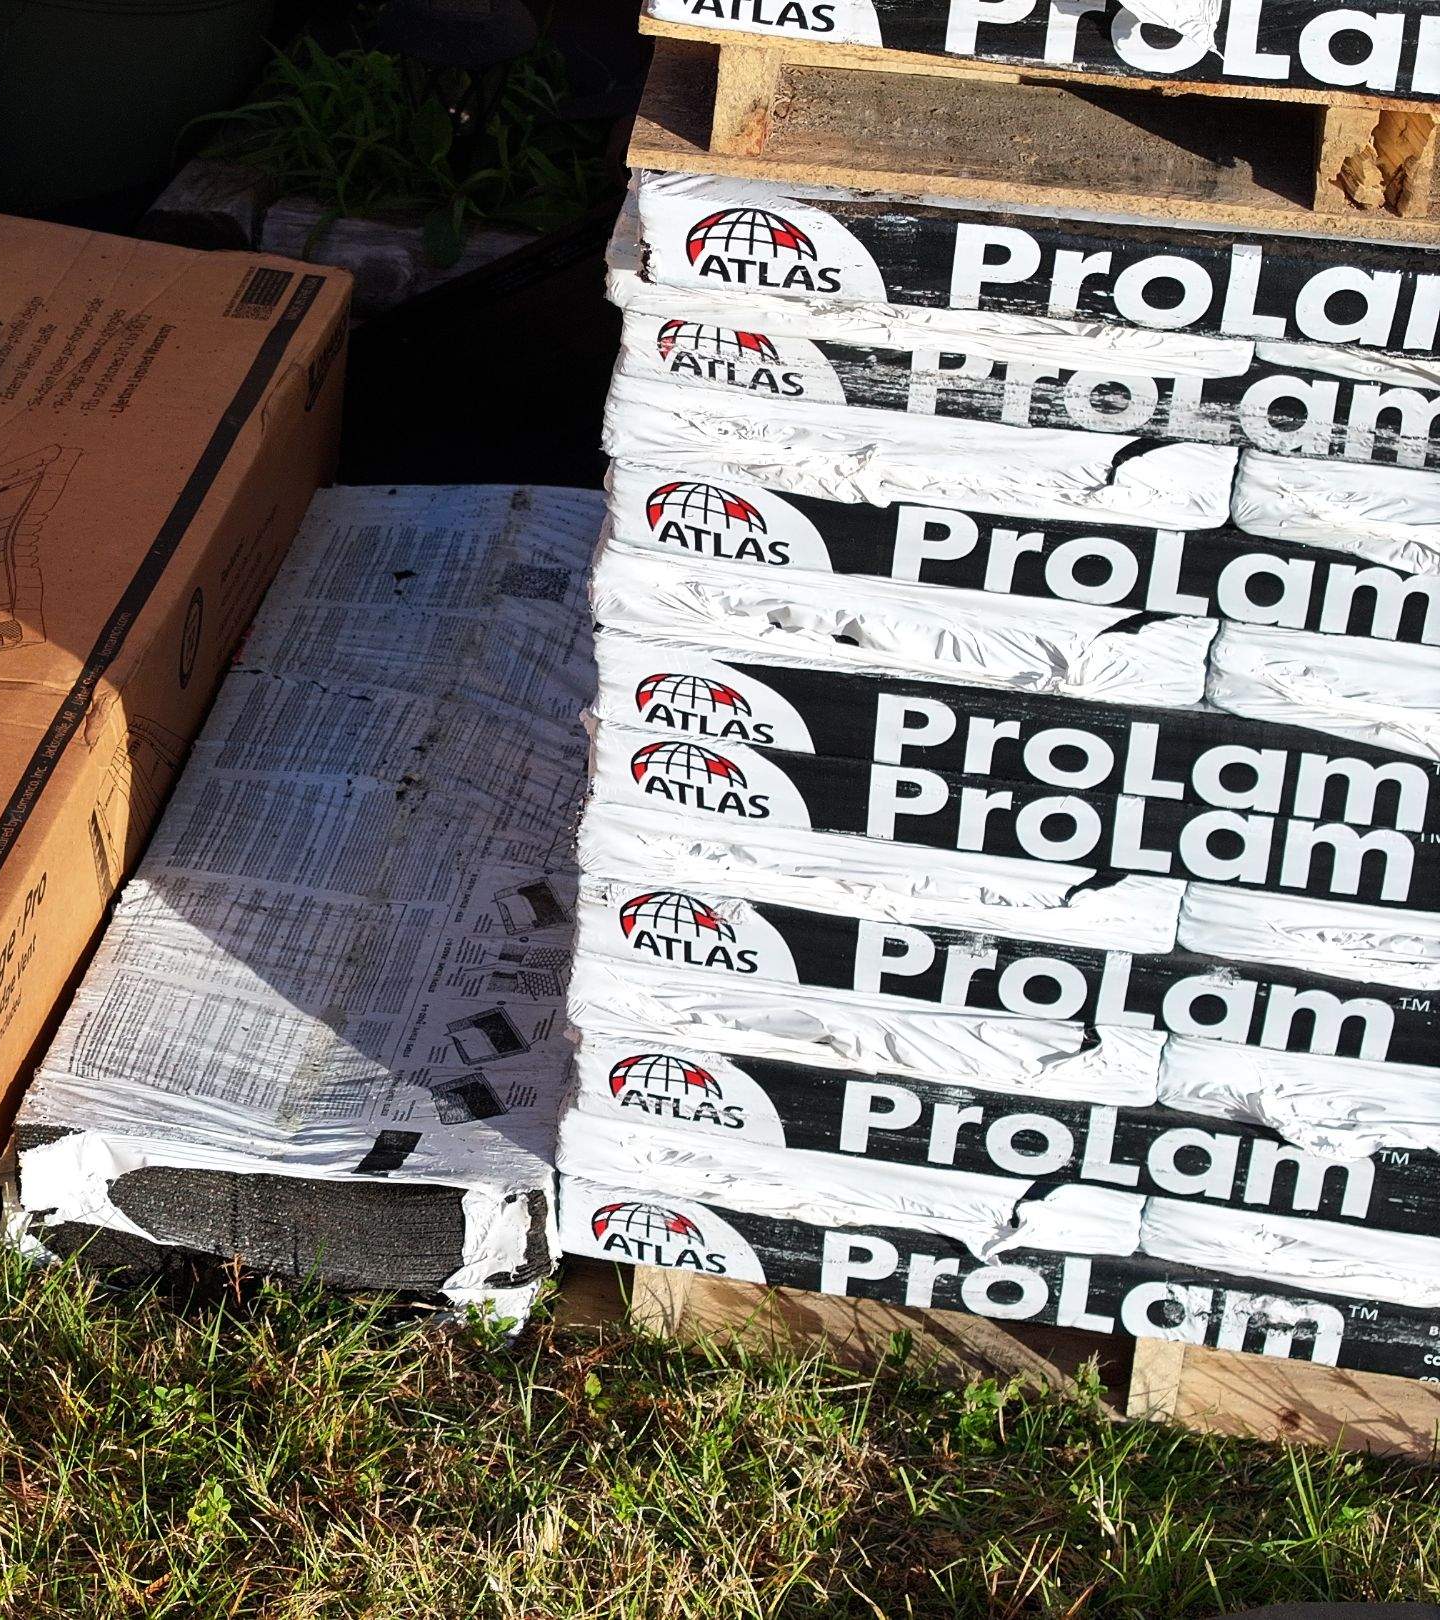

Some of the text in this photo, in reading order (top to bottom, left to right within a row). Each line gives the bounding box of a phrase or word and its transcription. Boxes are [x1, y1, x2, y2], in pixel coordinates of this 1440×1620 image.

[692, 0, 1440, 95] ATLAS ProLa
[699, 222, 1440, 350] ATLAS ProLa
[669, 350, 804, 397] ATLAS
[659, 520, 790, 565] ATLAS
[645, 692, 1431, 833] ATLAS ProLam
[645, 775, 770, 819] ATLAS
[866, 763, 1415, 902] ProLam
[14, 934, 37, 982] Vent
[22, 871, 48, 936] Pro
[633, 929, 758, 973] ATLAS
[853, 920, 1395, 1062] ProLam
[621, 1089, 745, 1130] ATLAS
[839, 1080, 1376, 1219] ProLam
[603, 1233, 726, 1275] ATLAS
[820, 1230, 1345, 1368] ProLam
